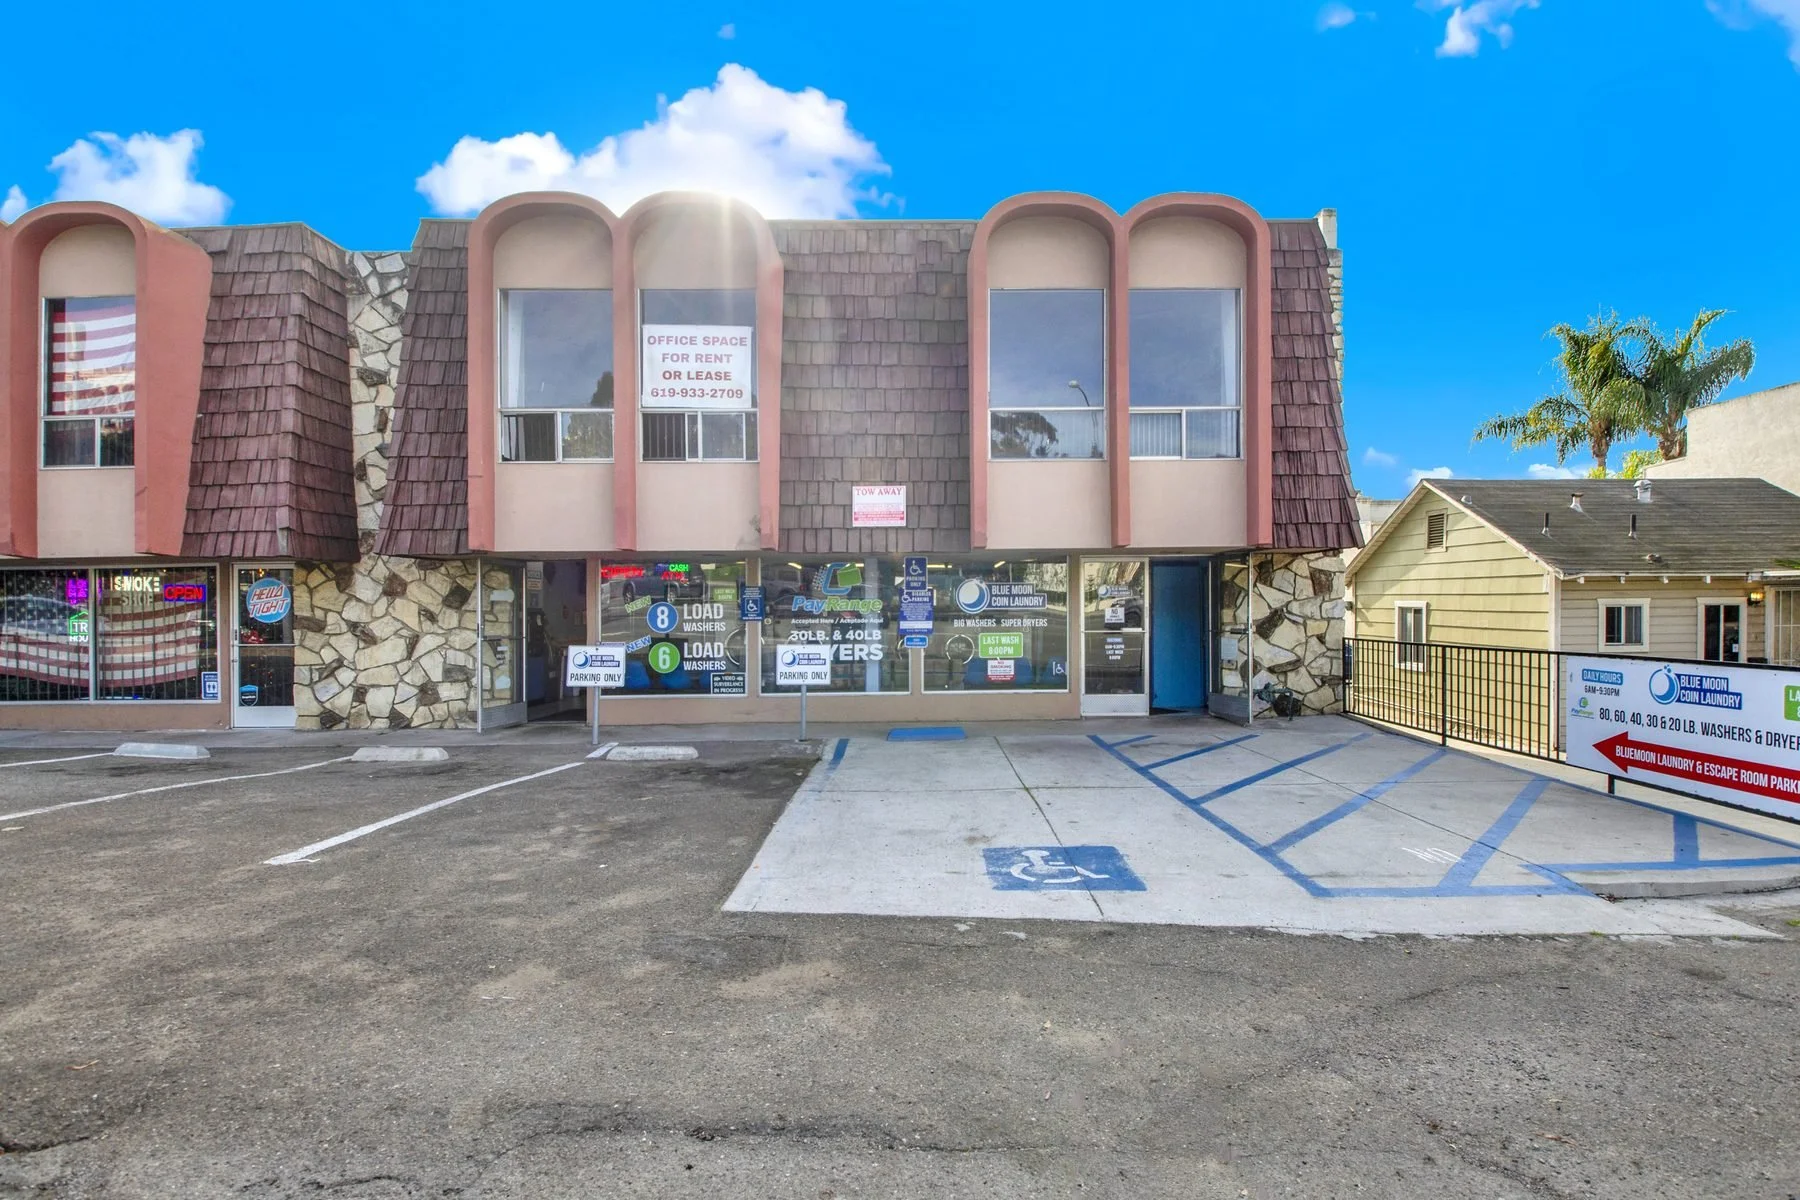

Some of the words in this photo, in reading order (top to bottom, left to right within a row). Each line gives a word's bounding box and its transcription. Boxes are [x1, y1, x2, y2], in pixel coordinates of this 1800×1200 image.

[647, 336, 698, 345] OFFICE
[702, 336, 748, 346] SPACE
[661, 353, 690, 363] FOR
[695, 353, 733, 363] RENT
[662, 370, 682, 380] OR
[687, 371, 732, 381] LEASE
[650, 388, 743, 398] 619-933-2709
[669, 563, 689, 572] CASH
[114, 576, 160, 592] SMOKE
[992, 585, 1010, 594] BLUE
[1011, 585, 1032, 594] MOON
[165, 586, 203, 600] OPEN
[250, 584, 285, 602] HELLA
[250, 598, 289, 616] TIGHT
[624, 594, 652, 613] NEW
[792, 595, 883, 614] PayRange
[991, 597, 1008, 606] COIN
[1010, 597, 1044, 606] LAUNDRY
[656, 606, 669, 628] 8
[683, 603, 724, 619] LOAD
[73, 622, 88, 633] TR
[683, 622, 726, 632] WASHERS
[953, 619, 965, 627] BIG
[966, 619, 996, 627] WASHERS
[1000, 619, 1021, 627] SUPER
[1022, 619, 1048, 627] DRYERS
[790, 630, 829, 641] 30LB.
[833, 630, 842, 641] &
[846, 630, 882, 641] 40LB
[983, 636, 998, 645] LAST
[1000, 636, 1020, 645] WASH
[626, 635, 652, 653] NEW
[683, 642, 724, 658] LOAD
[658, 646, 670, 670] 6
[830, 644, 884, 660] YERS
[683, 660, 726, 671] WASHERS
[570, 673, 601, 682] PARKING
[604, 673, 621, 682] ONLY
[779, 672, 808, 680] PARKING
[811, 672, 828, 680] ONLY
[1583, 670, 1599, 681] DAILY
[1600, 672, 1621, 684] HOURS
[1680, 675, 1700, 689] BLUE
[1702, 677, 1727, 691] MOON
[1680, 690, 1699, 703] COIN
[1701, 692, 1741, 708] LAUNDRY
[1600, 708, 1612, 722] 80,
[1614, 710, 1628, 724] 60,
[1630, 712, 1644, 728] 40,
[1646, 714, 1658, 728] 30
[1660, 716, 1666, 729] &
[1669, 717, 1680, 731] 20
[1683, 719, 1698, 734] LB.
[1701, 722, 1752, 743] WASHERS
[1755, 730, 1762, 744] &
[1616, 745, 1656, 764] BLUEMOON
[1657, 753, 1694, 772] LAUNDRY
[1696, 761, 1702, 774] &
[1704, 762, 1738, 781] ESCAPE
[1740, 769, 1768, 788] ROOM
